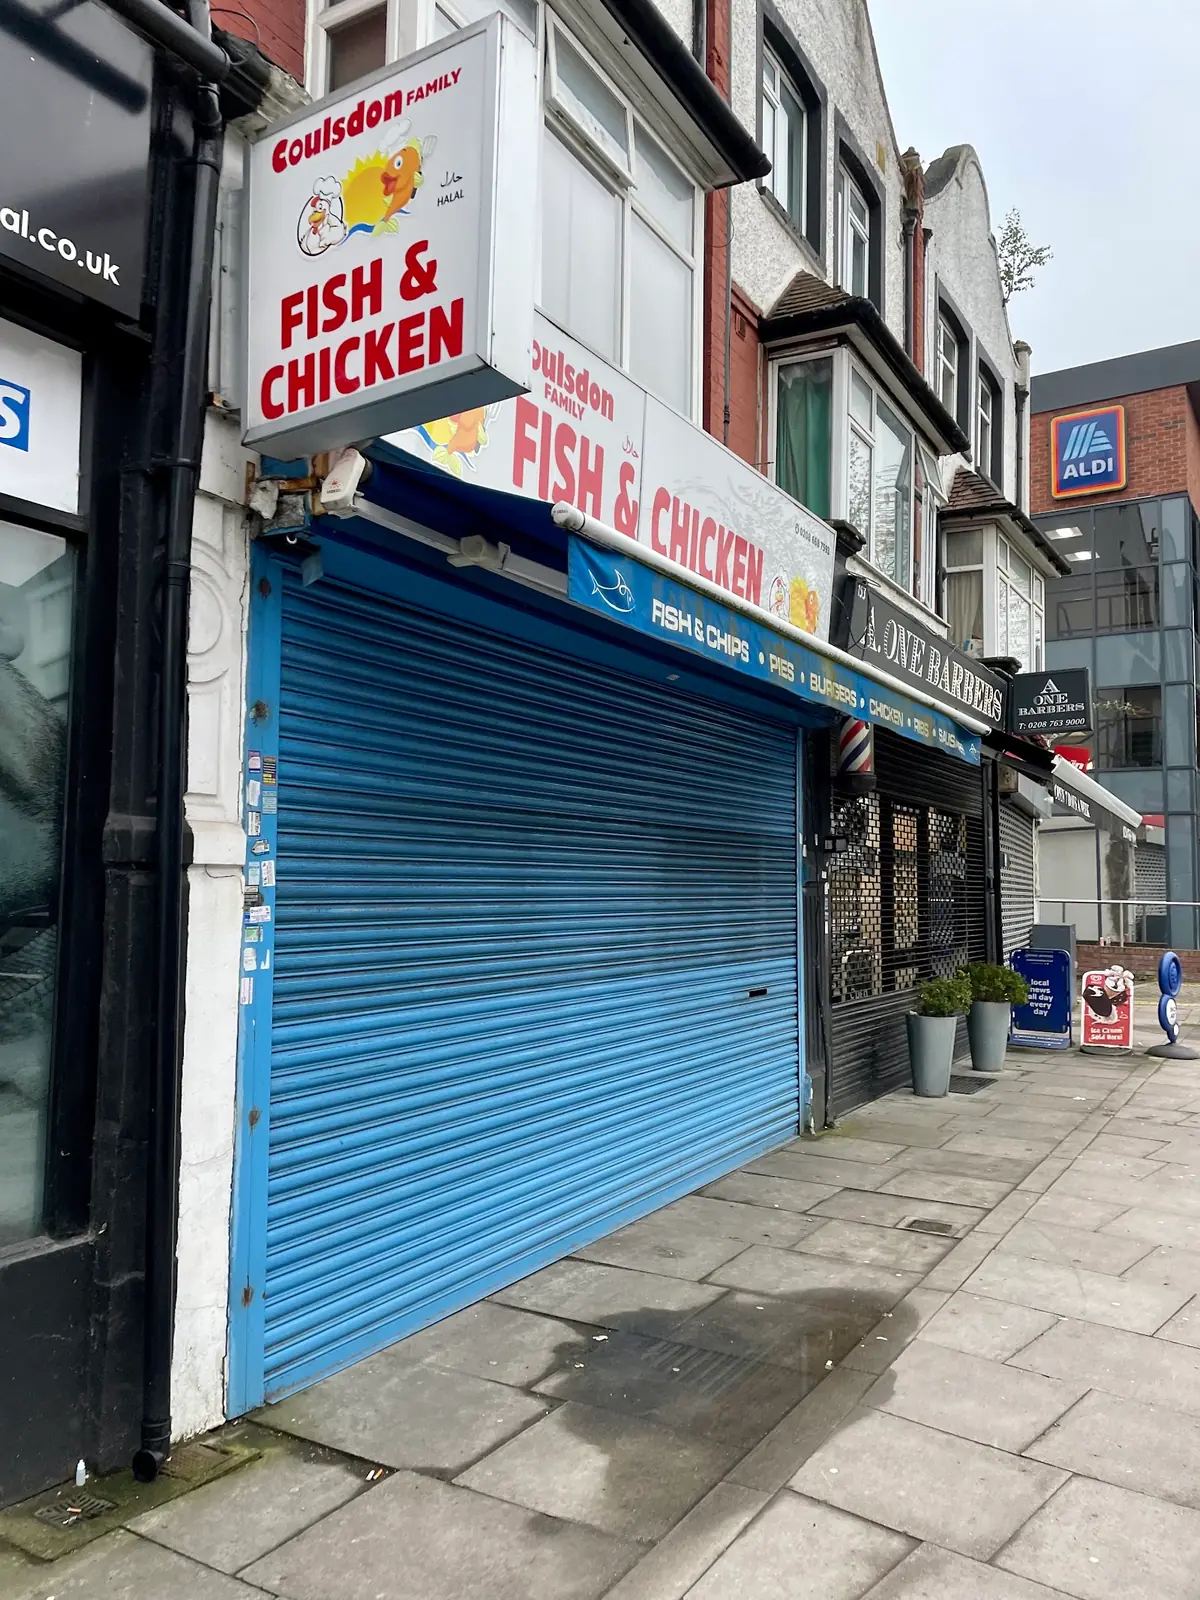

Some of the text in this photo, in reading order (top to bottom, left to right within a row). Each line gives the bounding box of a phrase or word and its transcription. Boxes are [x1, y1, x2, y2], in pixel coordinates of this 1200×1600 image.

[272, 67, 462, 174] Coulsdon FAMILY
[437, 189, 465, 207] HALAL
[281, 239, 438, 350] FISH &
[260, 297, 464, 420] CHICKEN
[532, 339, 614, 422] oulsdon
[544, 382, 585, 421] FAMILY
[1063, 457, 1113, 480] ALDI
[512, 397, 763, 607] FISH & CHICKEN
[652, 598, 692, 636] FISH
[694, 618, 704, 643] &
[706, 624, 749, 663] CHIPS
[769, 653, 795, 684] PIES
[810, 672, 857, 708] BURGERS
[869, 698, 904, 727] CHICKEN
[883, 618, 926, 678] ONE
[925, 645, 1002, 722] BARBERS
[1040, 679, 1060, 694] A
[1018, 703, 1085, 716] BARBERS
[1033, 692, 1068, 706] ONE
[1028, 721, 1047, 729] 0208
[1049, 719, 1063, 727] 763
[1065, 717, 1085, 726] 9000
[1029, 1001, 1052, 1010] every
[1038, 994, 1054, 1003] day
[1033, 1008, 1049, 1017] day
